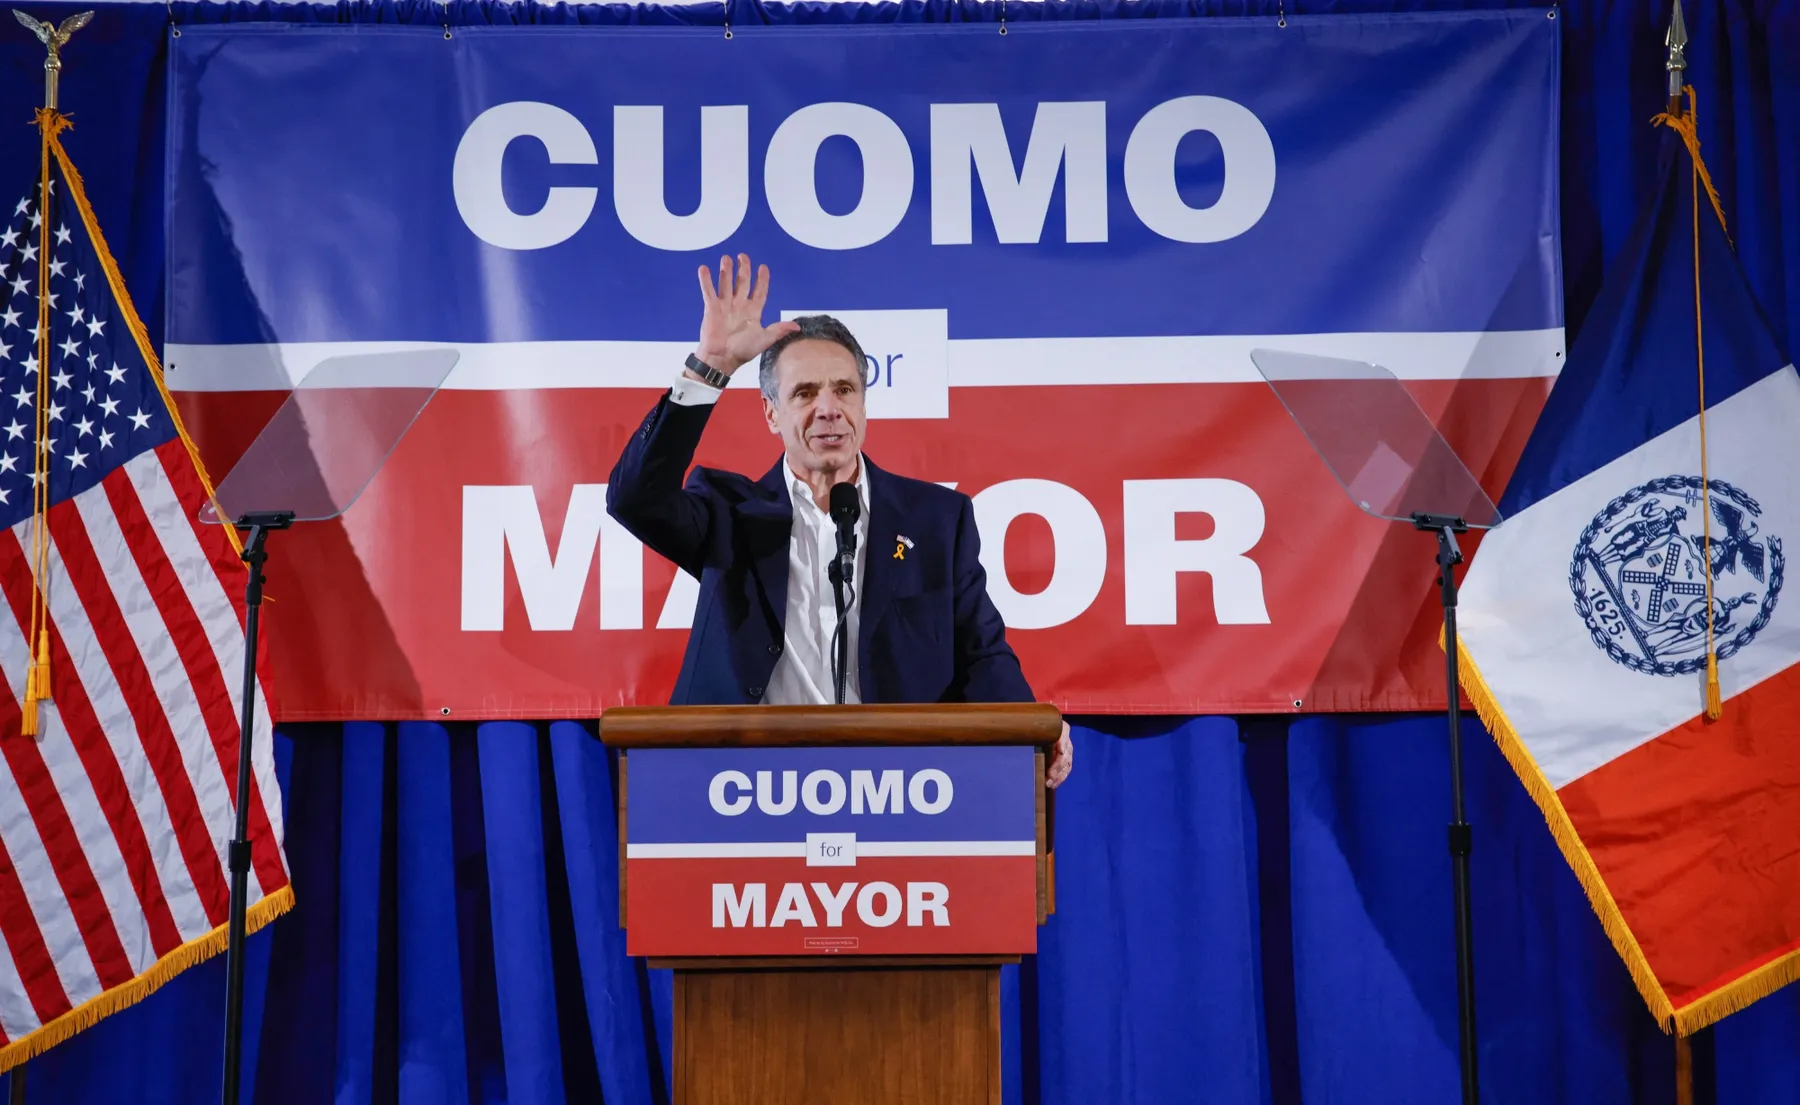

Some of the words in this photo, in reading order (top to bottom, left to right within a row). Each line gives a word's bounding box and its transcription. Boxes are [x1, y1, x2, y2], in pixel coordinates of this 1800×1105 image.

[453, 95, 1276, 251] CUOMO
[461, 478, 1271, 631] MOR
[708, 768, 954, 816] CUOMO
[820, 841, 843, 858] for
[712, 882, 950, 928] MAYOR
